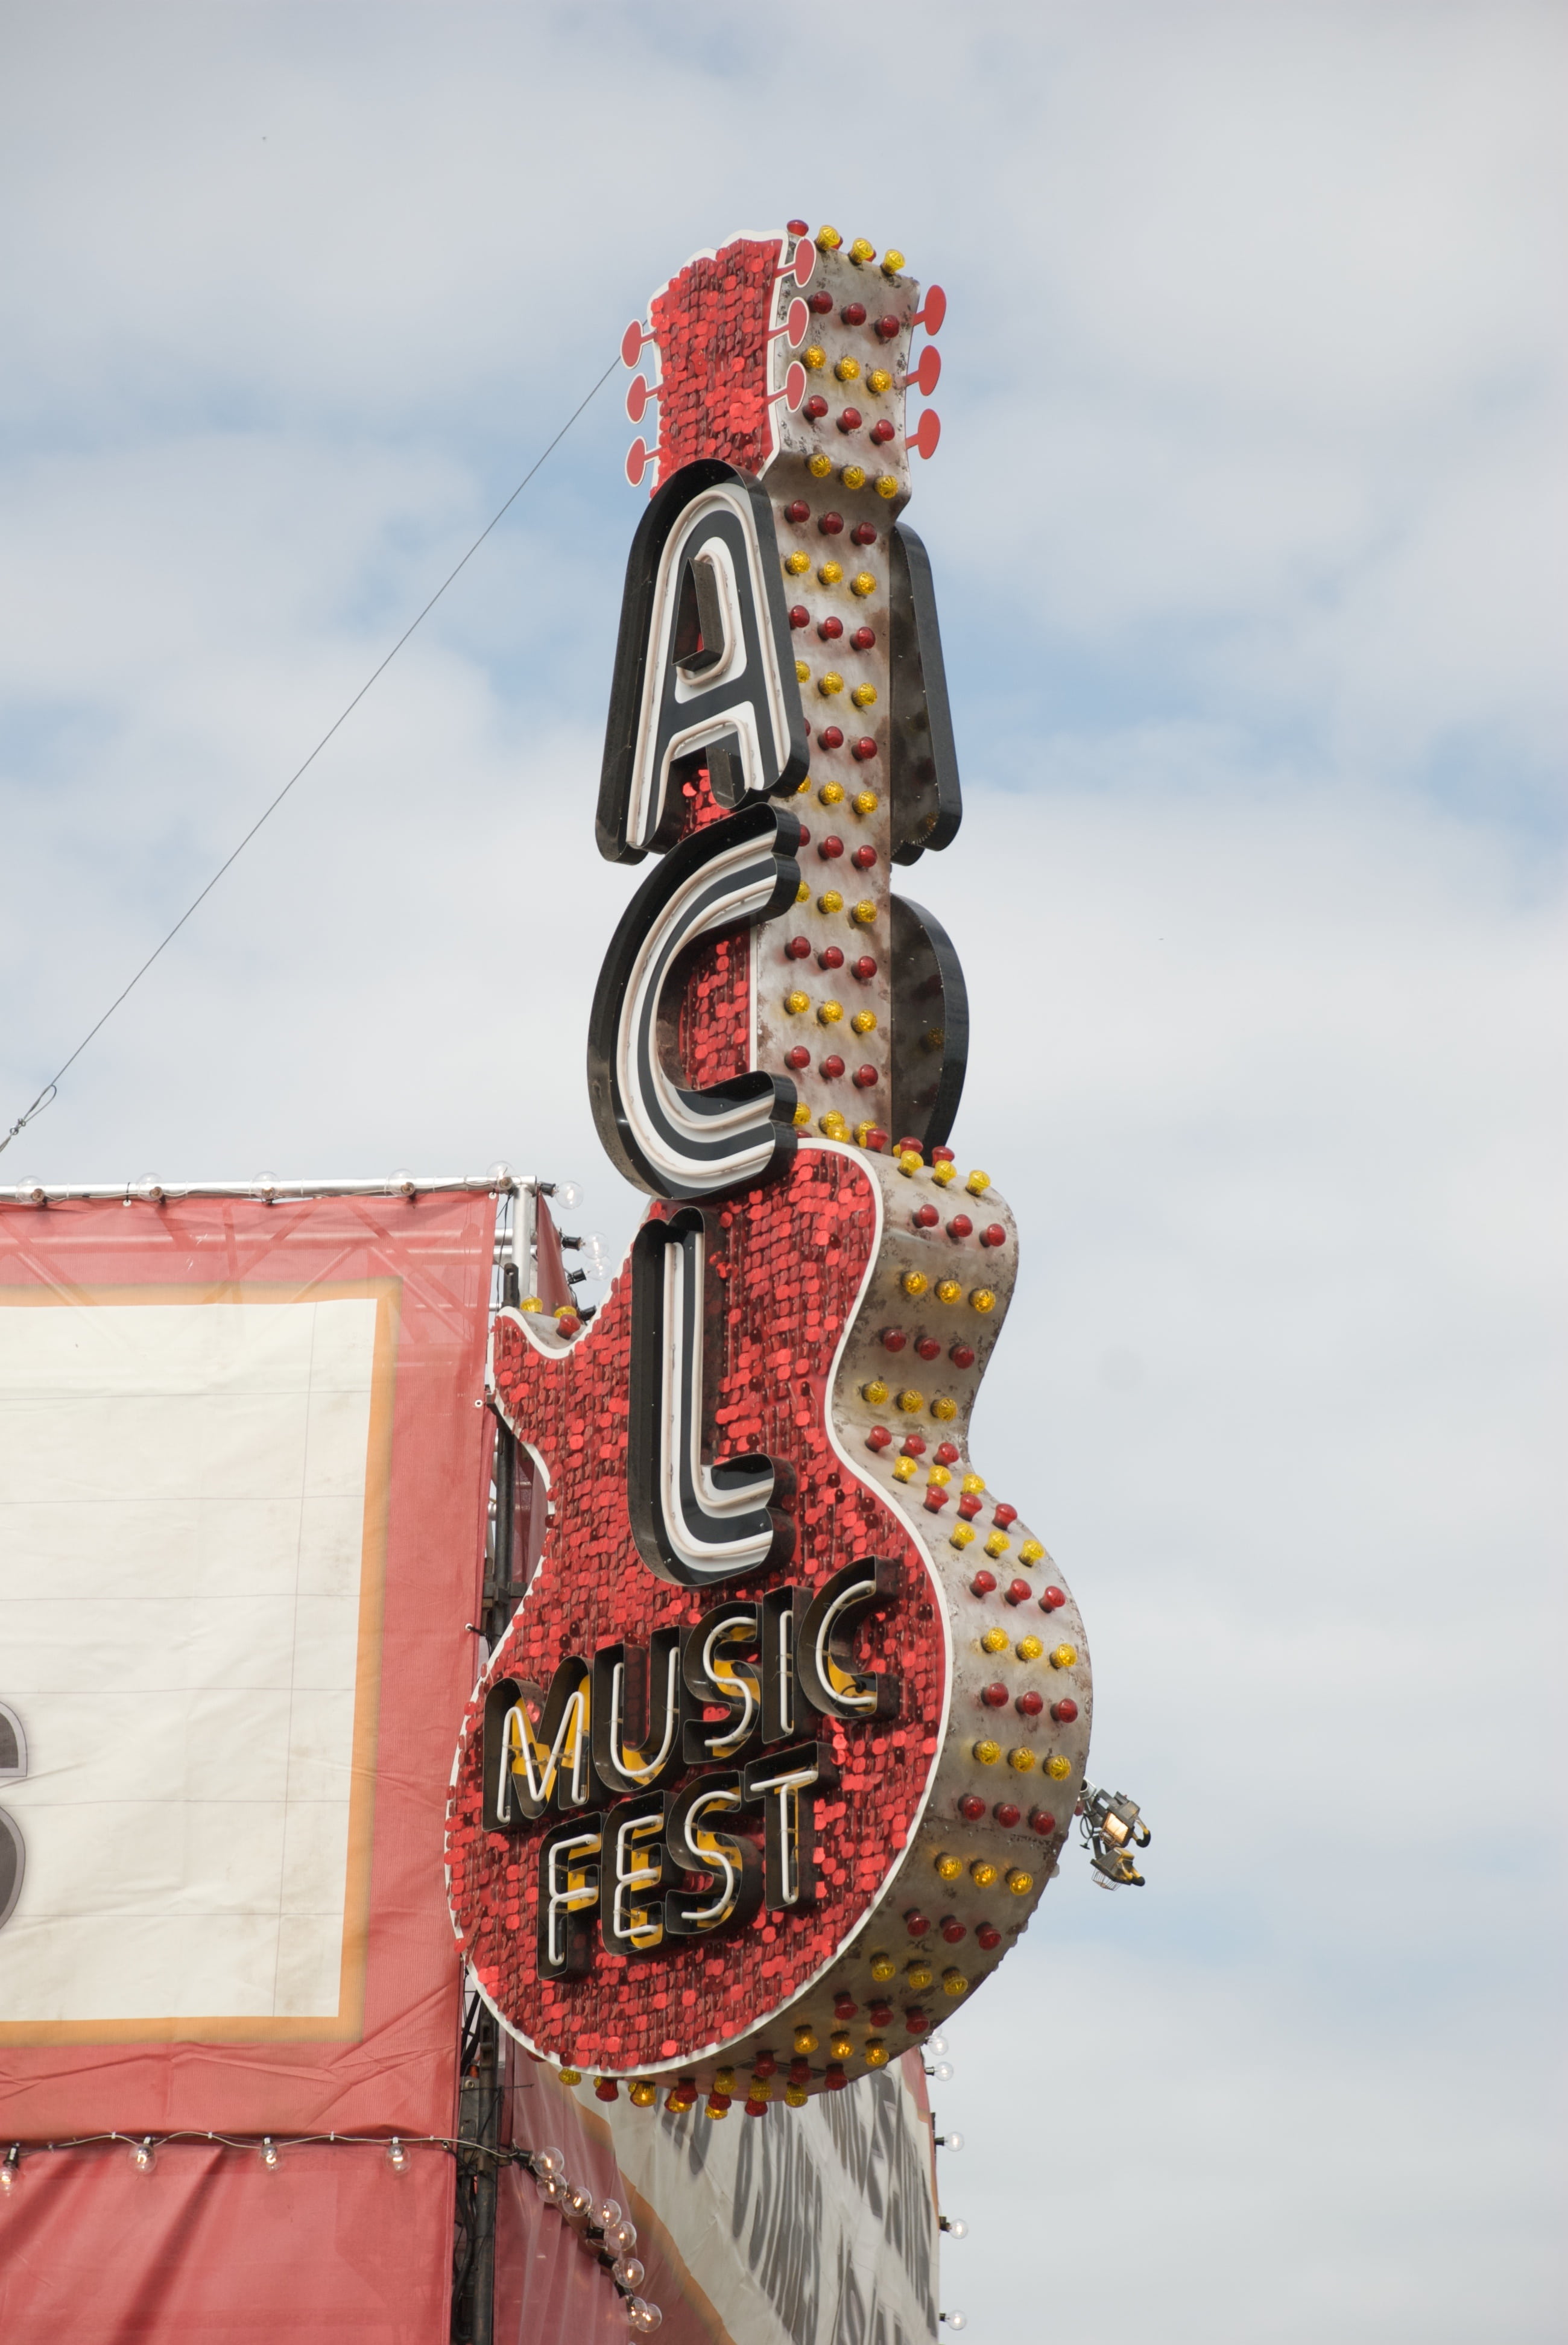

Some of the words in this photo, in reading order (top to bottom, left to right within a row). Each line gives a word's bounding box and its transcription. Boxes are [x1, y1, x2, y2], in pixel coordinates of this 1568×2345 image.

[587, 458, 809, 1587] ACL
[482, 1555, 899, 1832] MUSIC
[537, 1741, 840, 1981] FEST
